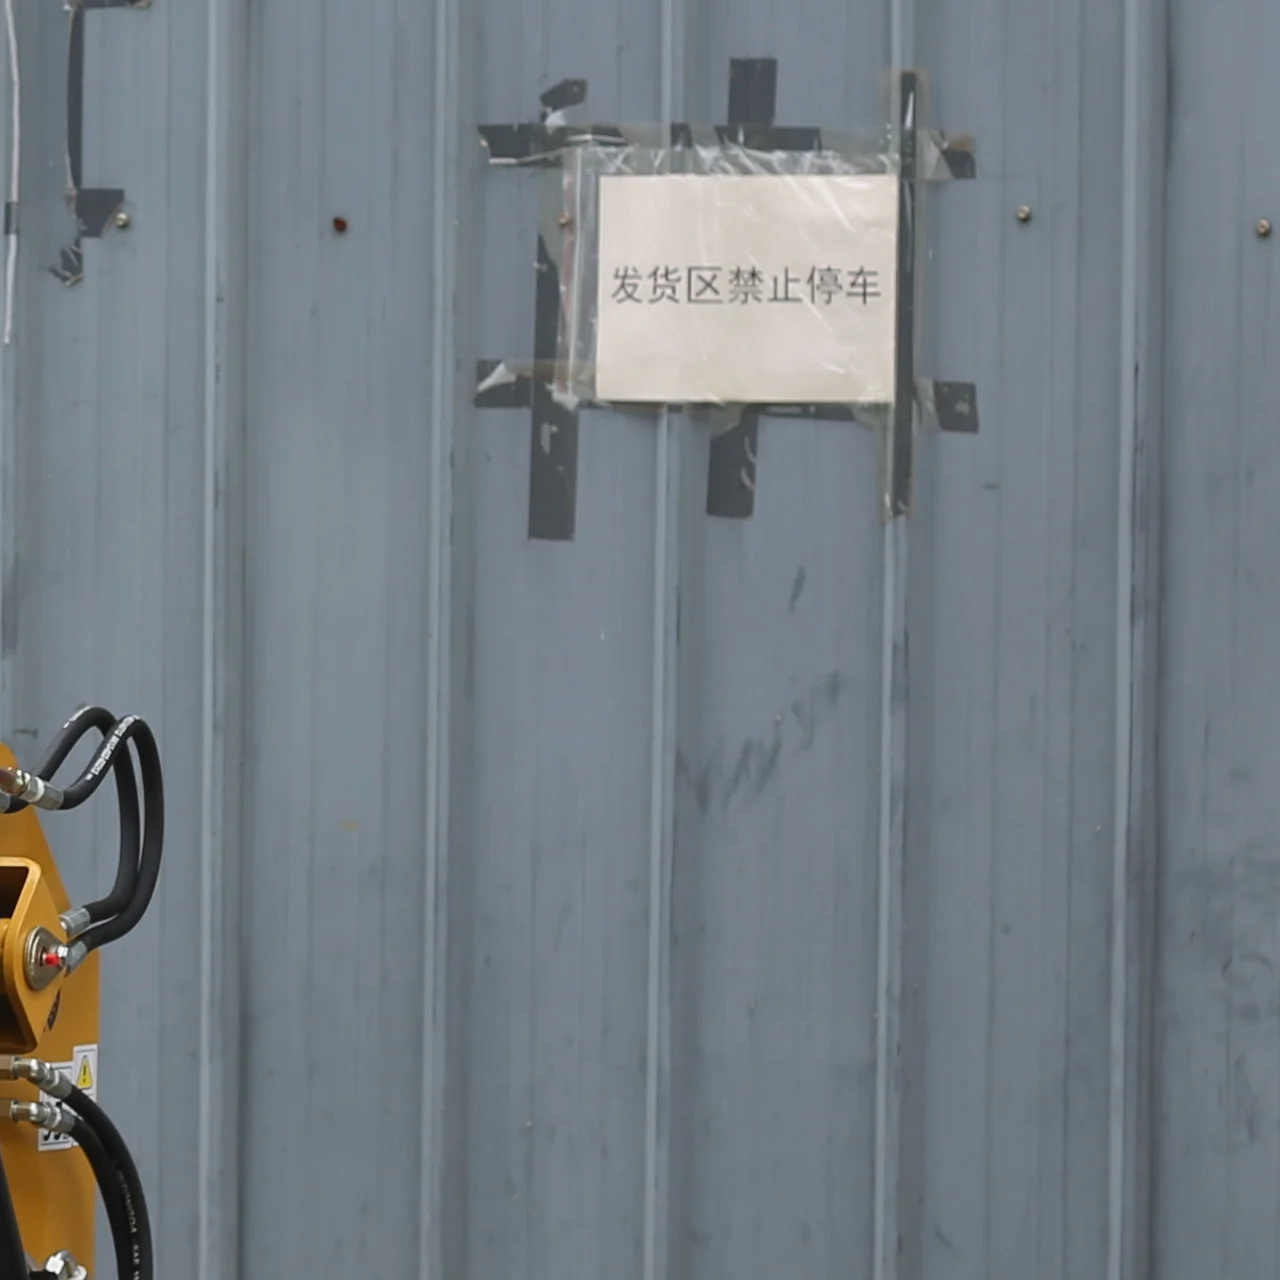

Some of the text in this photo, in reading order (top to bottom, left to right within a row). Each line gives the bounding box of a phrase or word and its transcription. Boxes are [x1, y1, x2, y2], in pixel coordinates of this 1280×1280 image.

[610, 265, 882, 306] 发货区禁止停车
